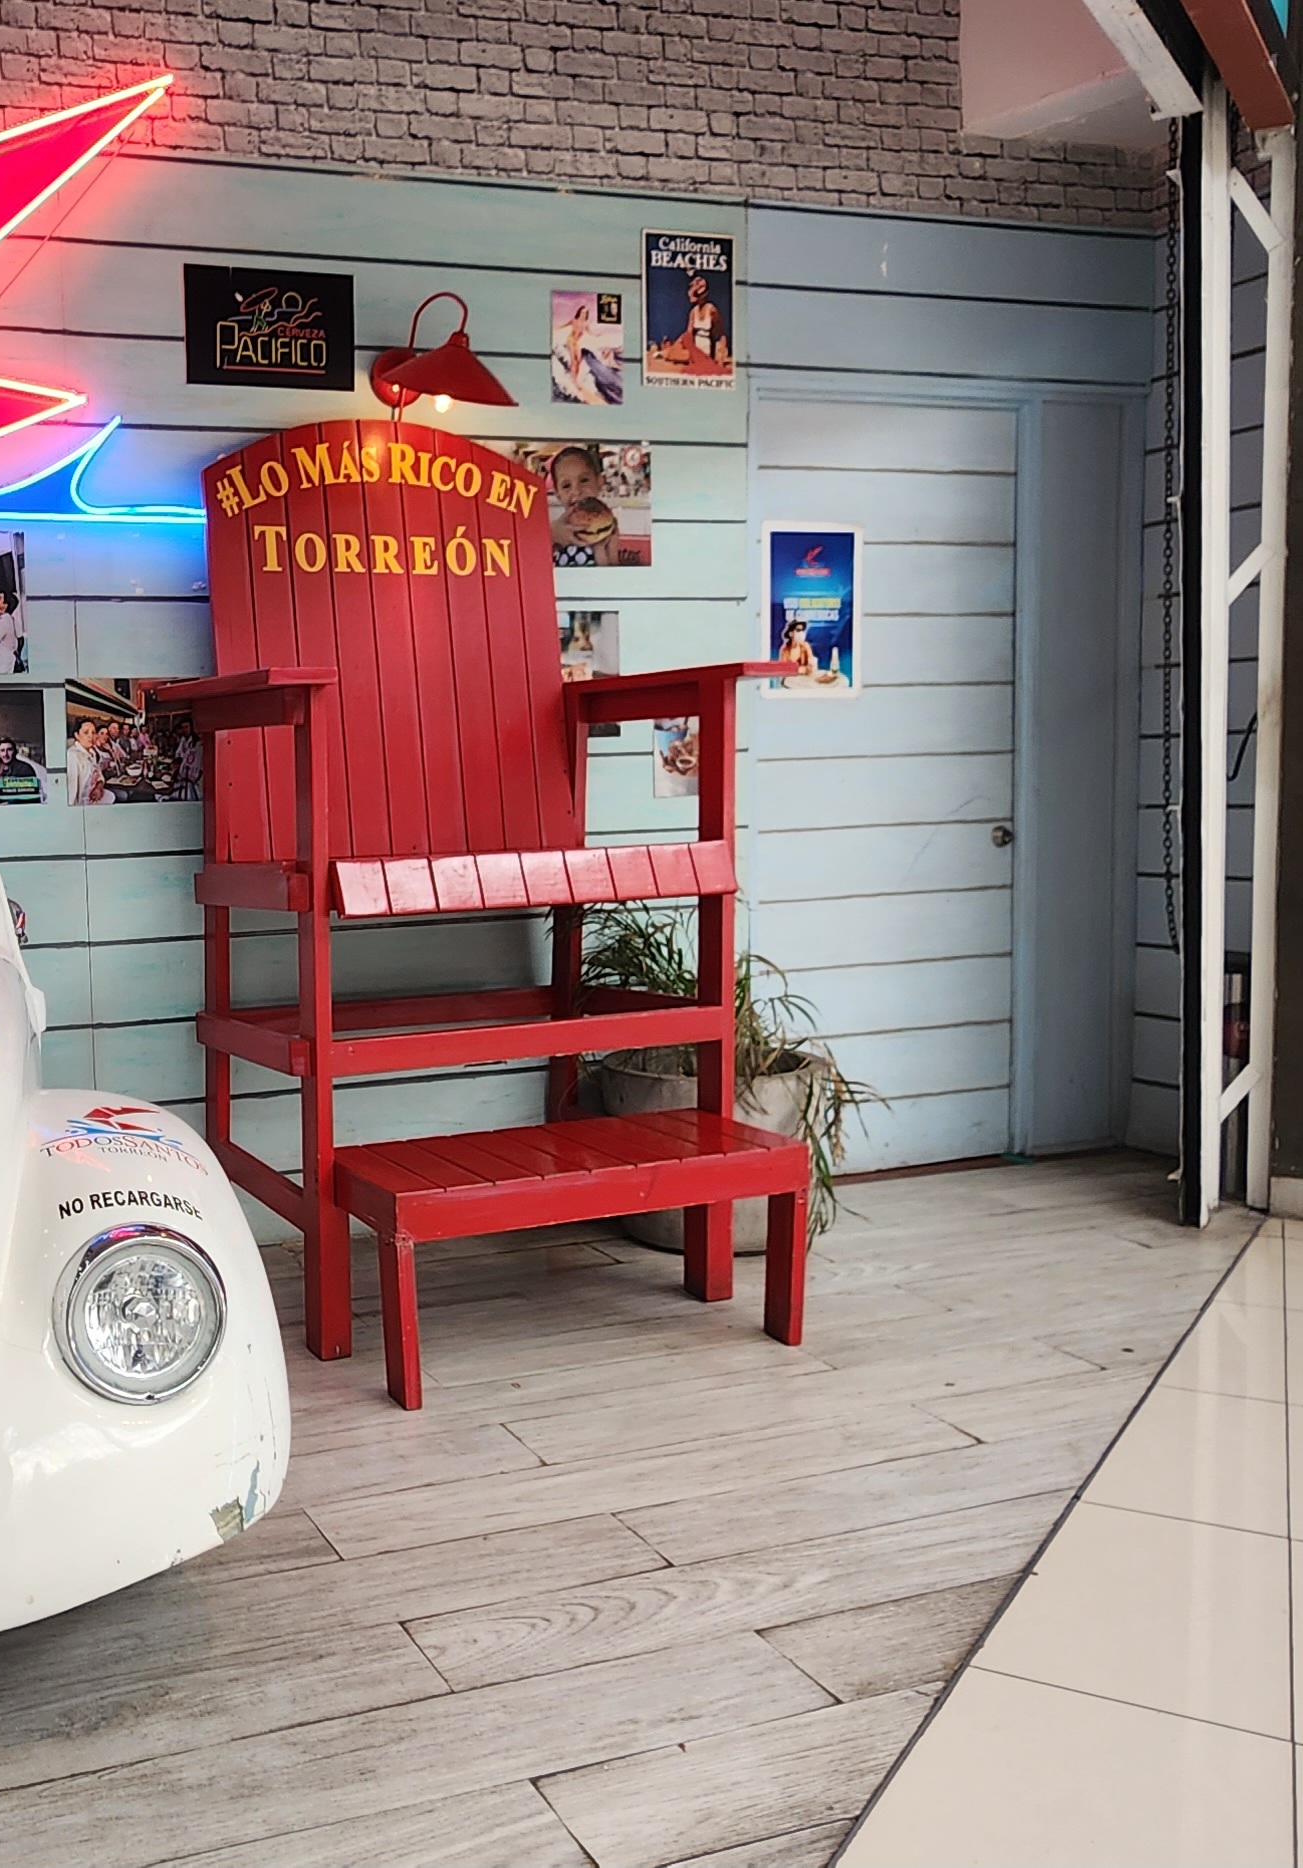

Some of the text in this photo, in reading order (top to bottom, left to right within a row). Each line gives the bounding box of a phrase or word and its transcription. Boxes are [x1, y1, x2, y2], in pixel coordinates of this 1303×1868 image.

[658, 236, 722, 254] California
[650, 250, 728, 272] BEACHES
[216, 321, 327, 368] PACIFICO
[277, 327, 326, 338] CERVEZA
[645, 376, 734, 388] SOUTHERN PACIFIC
[216, 440, 538, 519] #LO MÁS RICO EN
[253, 525, 512, 578] TORREÓN
[58, 1190, 204, 1221] NO RECARGARSE
